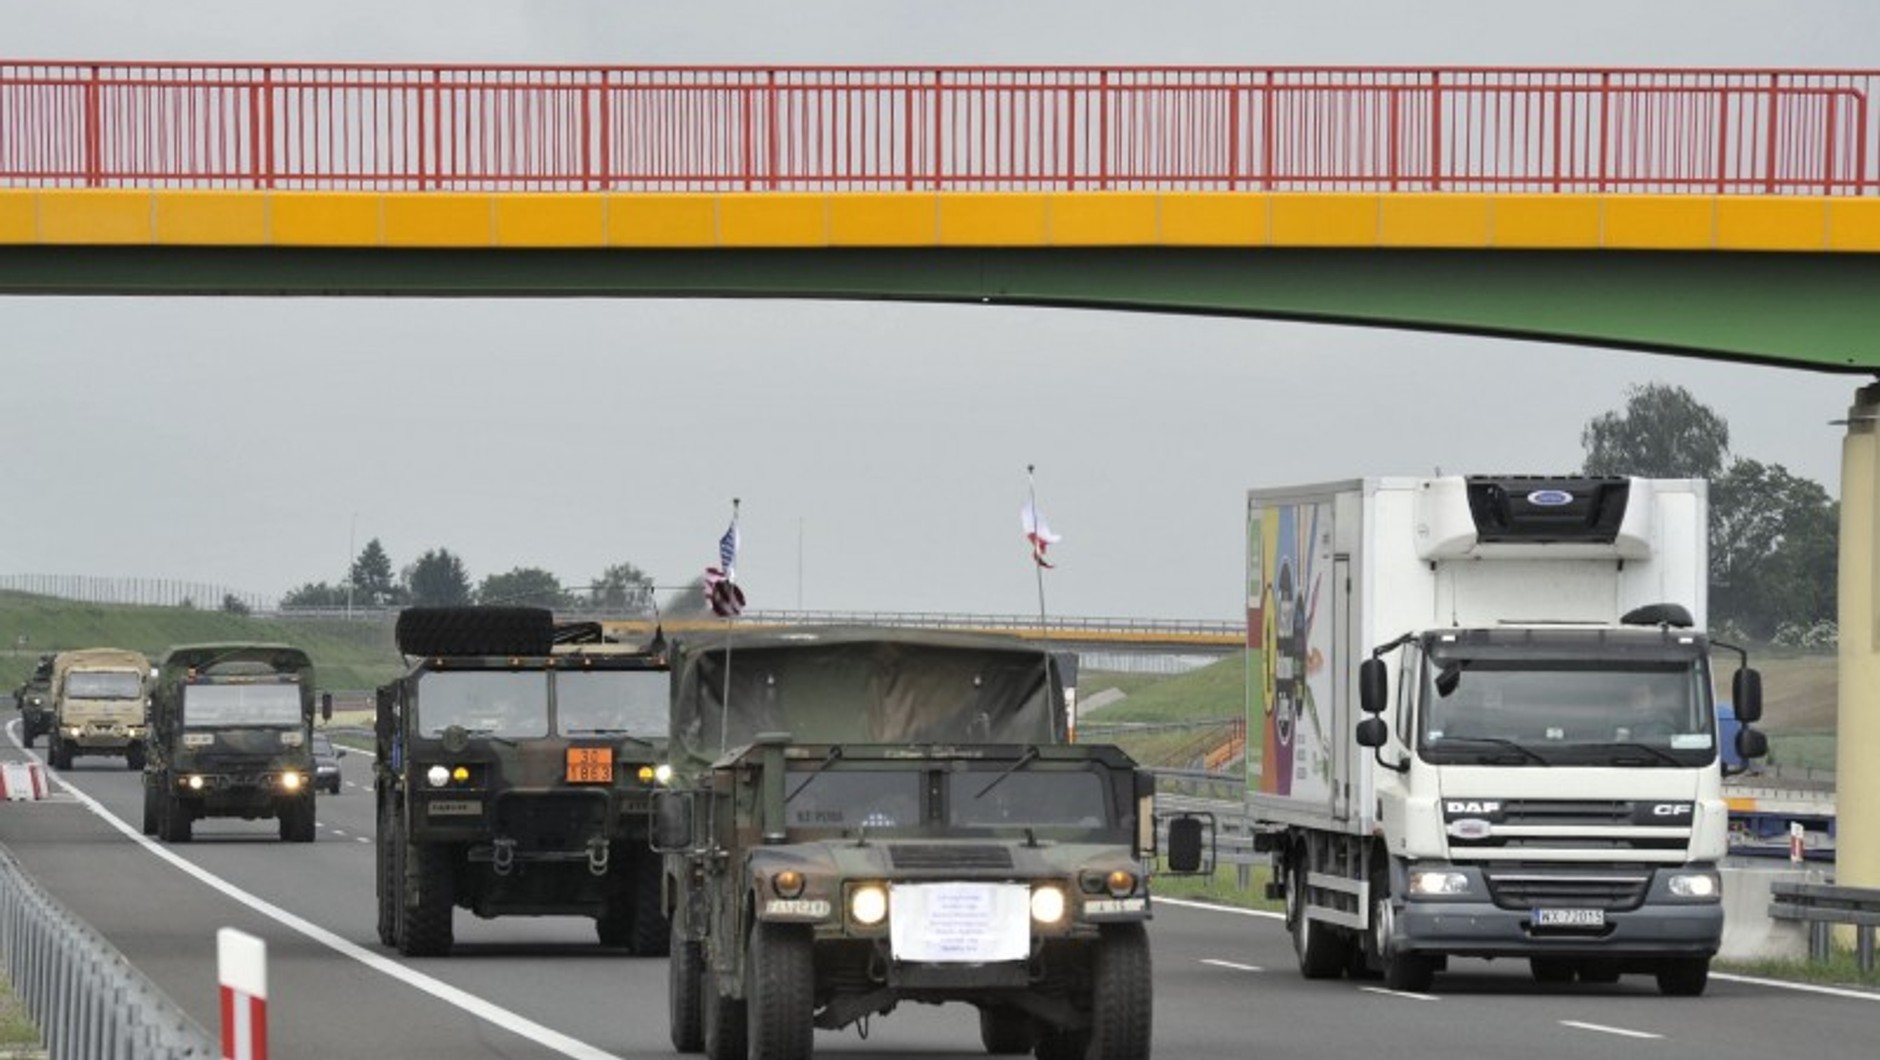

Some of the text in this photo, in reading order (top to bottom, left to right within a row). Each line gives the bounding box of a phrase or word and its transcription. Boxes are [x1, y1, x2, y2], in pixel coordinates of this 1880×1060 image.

[581, 750, 598, 763] 30
[1447, 801, 1500, 813] DAF
[1653, 804, 1692, 815] CF
